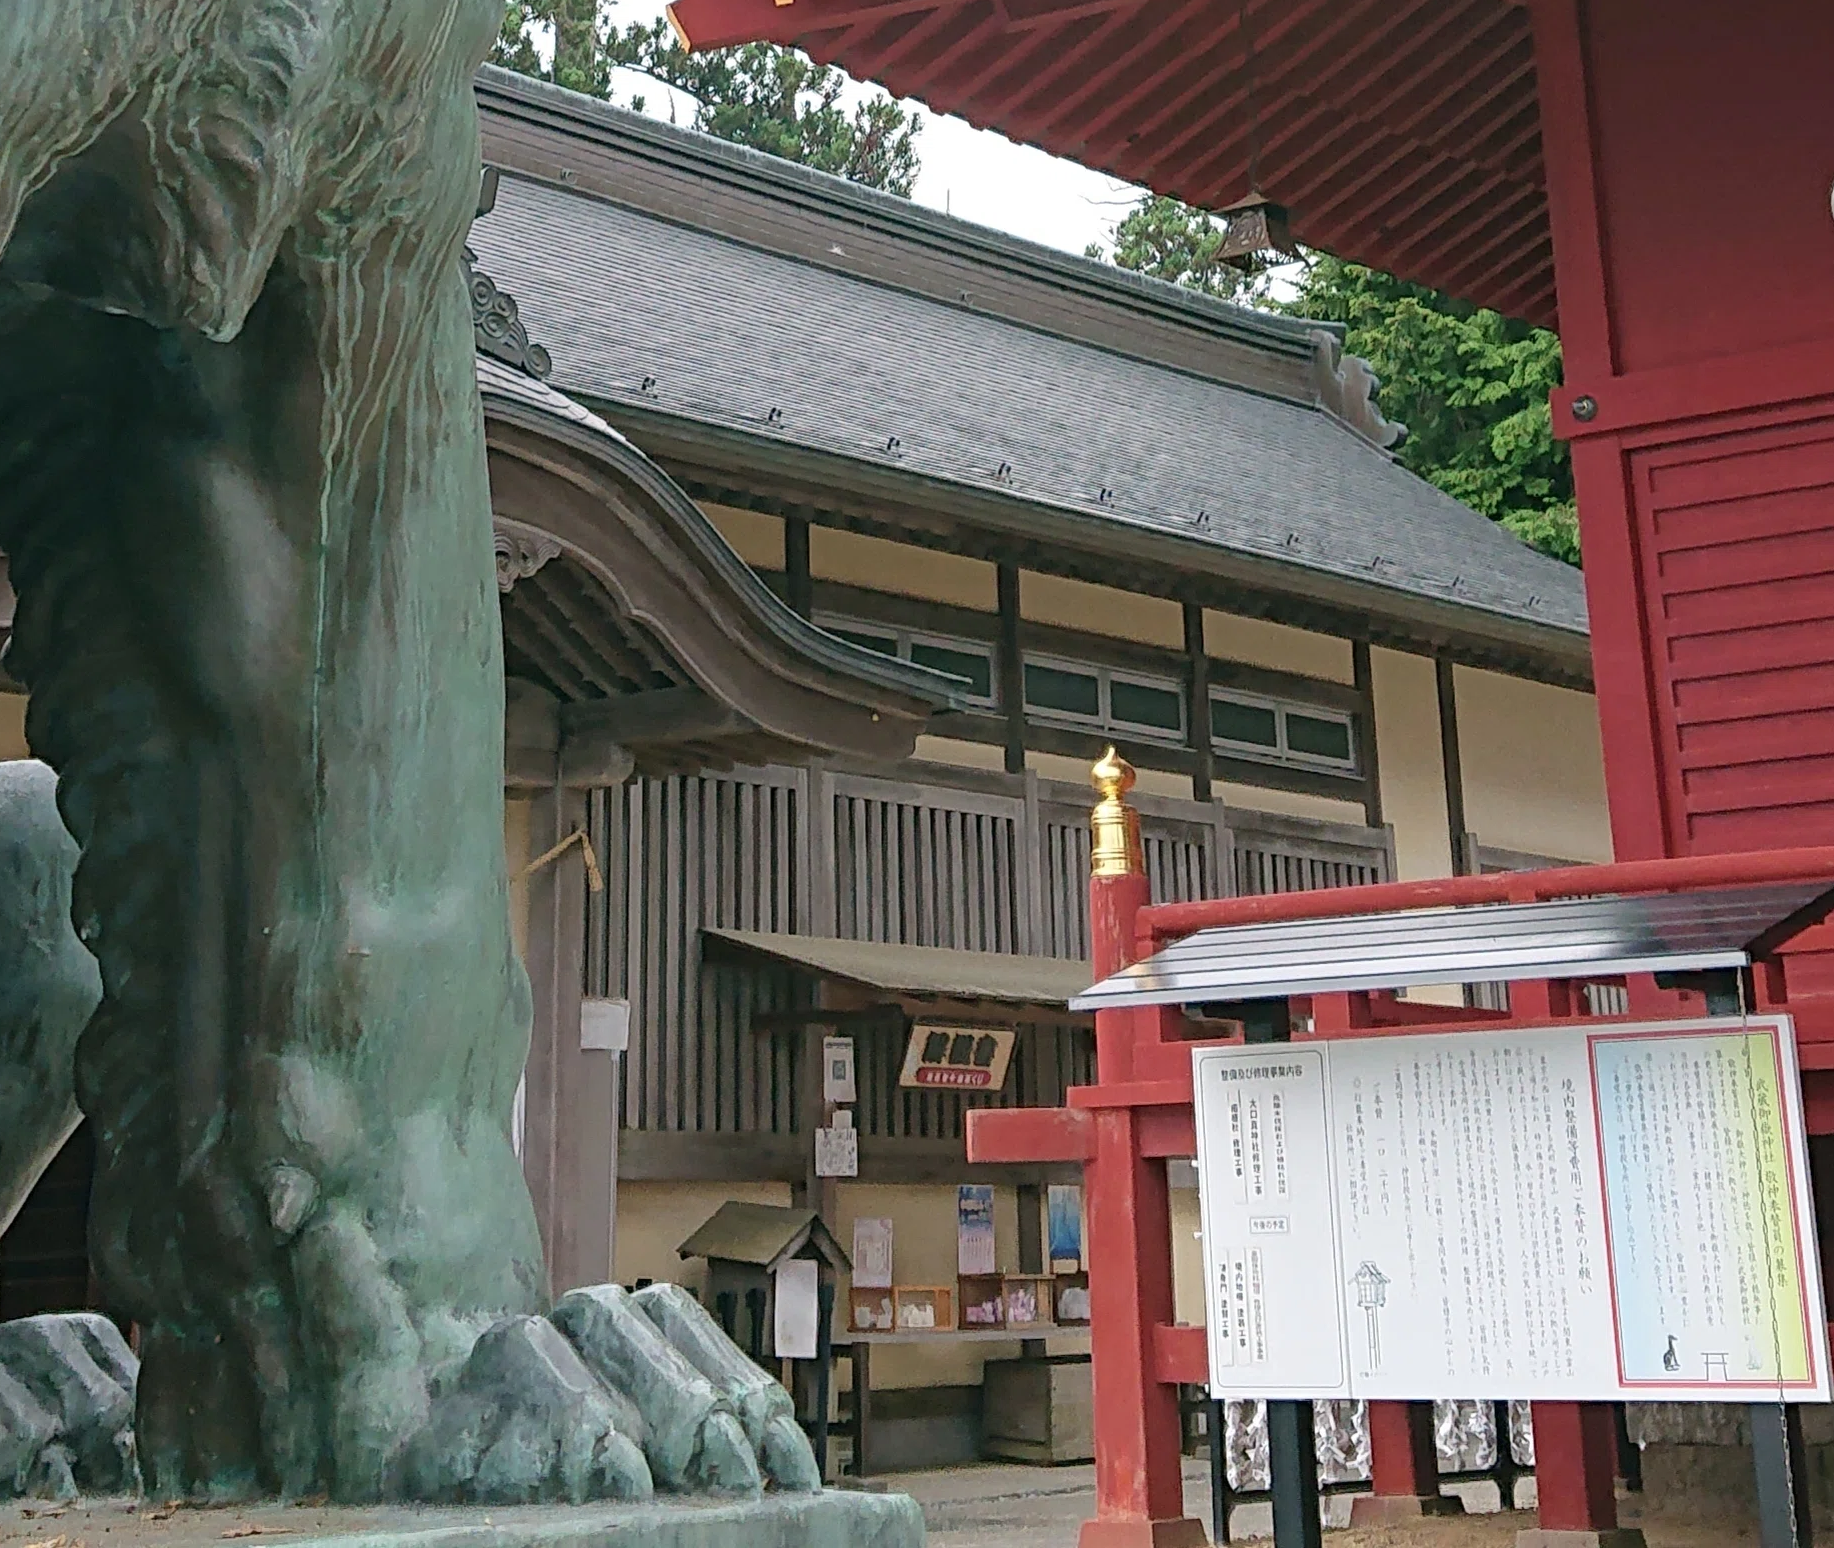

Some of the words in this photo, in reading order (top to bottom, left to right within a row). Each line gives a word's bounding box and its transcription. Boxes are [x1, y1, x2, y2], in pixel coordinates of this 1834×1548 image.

[1253, 1220, 1285, 1230] 今後の予定
